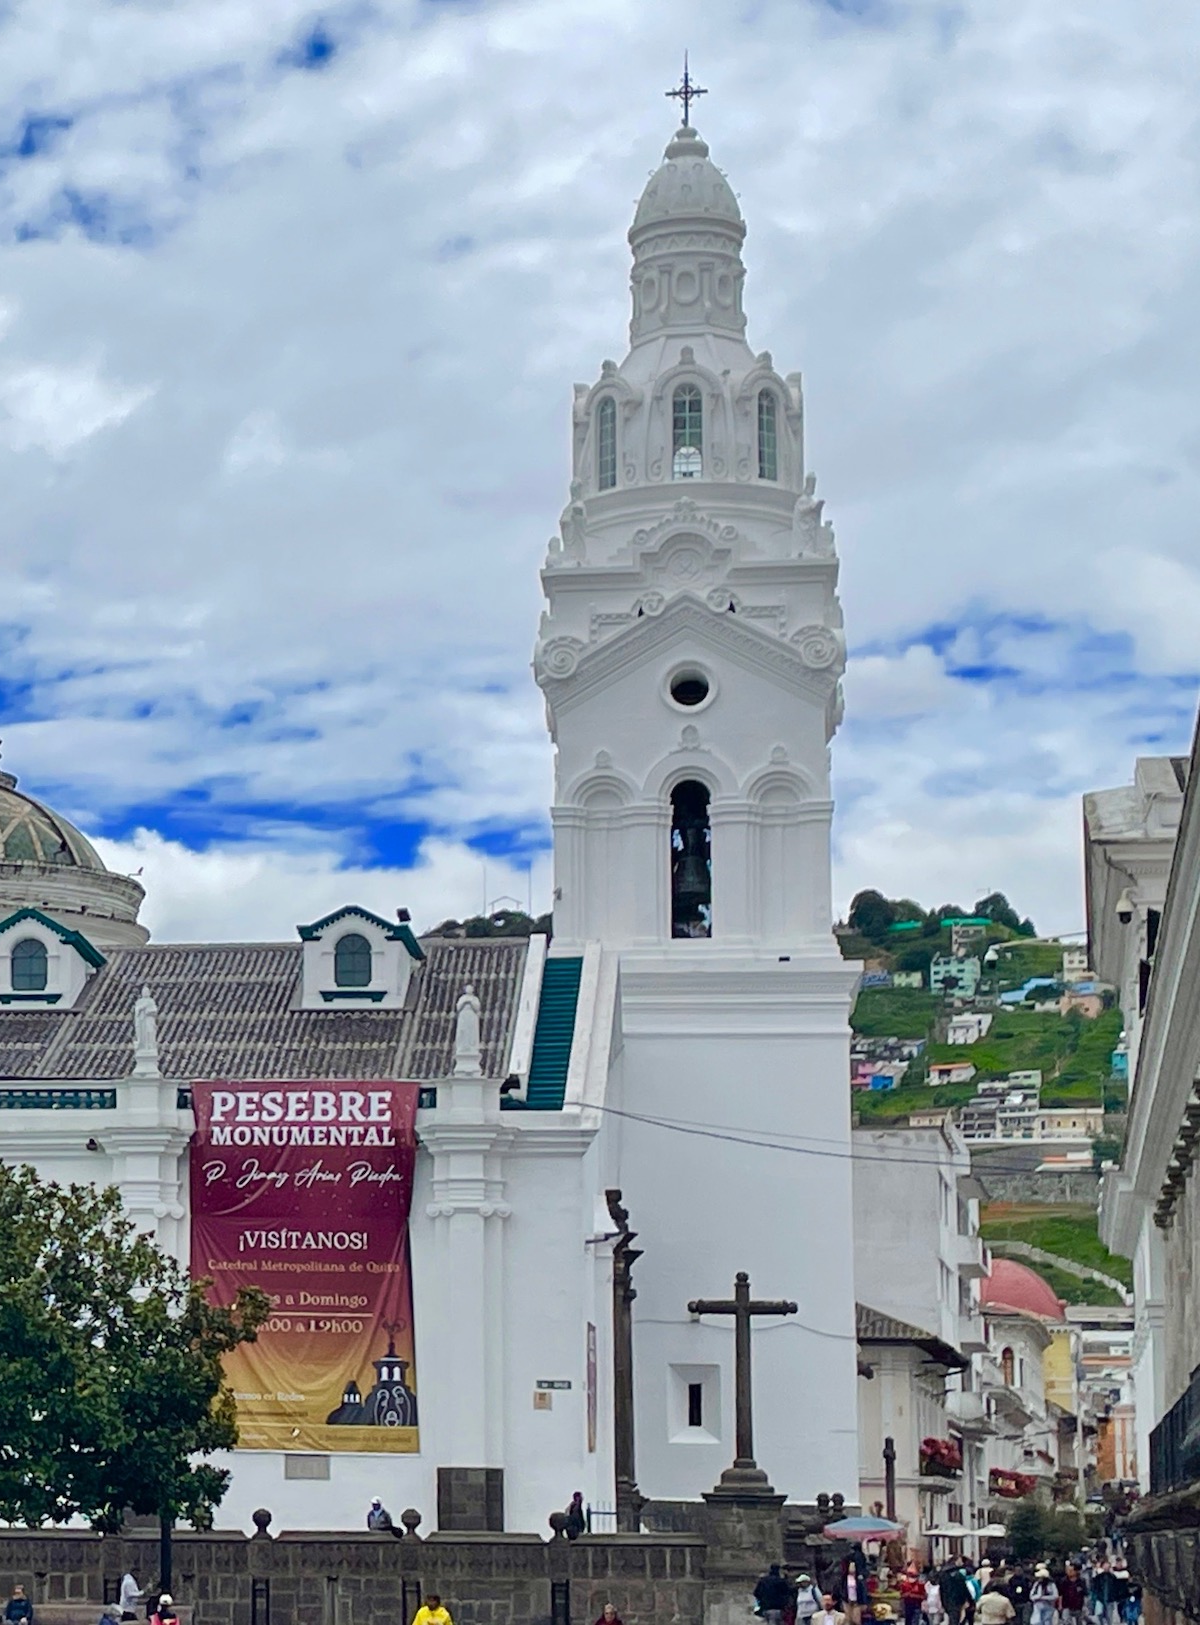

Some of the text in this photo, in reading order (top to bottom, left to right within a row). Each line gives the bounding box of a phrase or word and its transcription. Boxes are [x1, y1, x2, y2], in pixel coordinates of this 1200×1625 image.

[210, 1091, 393, 1122] PESEBRE
[211, 1126, 396, 1146] MONUMENTAL
[239, 1228, 368, 1251] ¡VISÍTANOS!
[208, 1259, 400, 1274] Catedral Metropolitana de Quito
[285, 1294, 295, 1305] a
[299, 1291, 368, 1309] Domingo
[309, 1319, 363, 1334] 19h00
